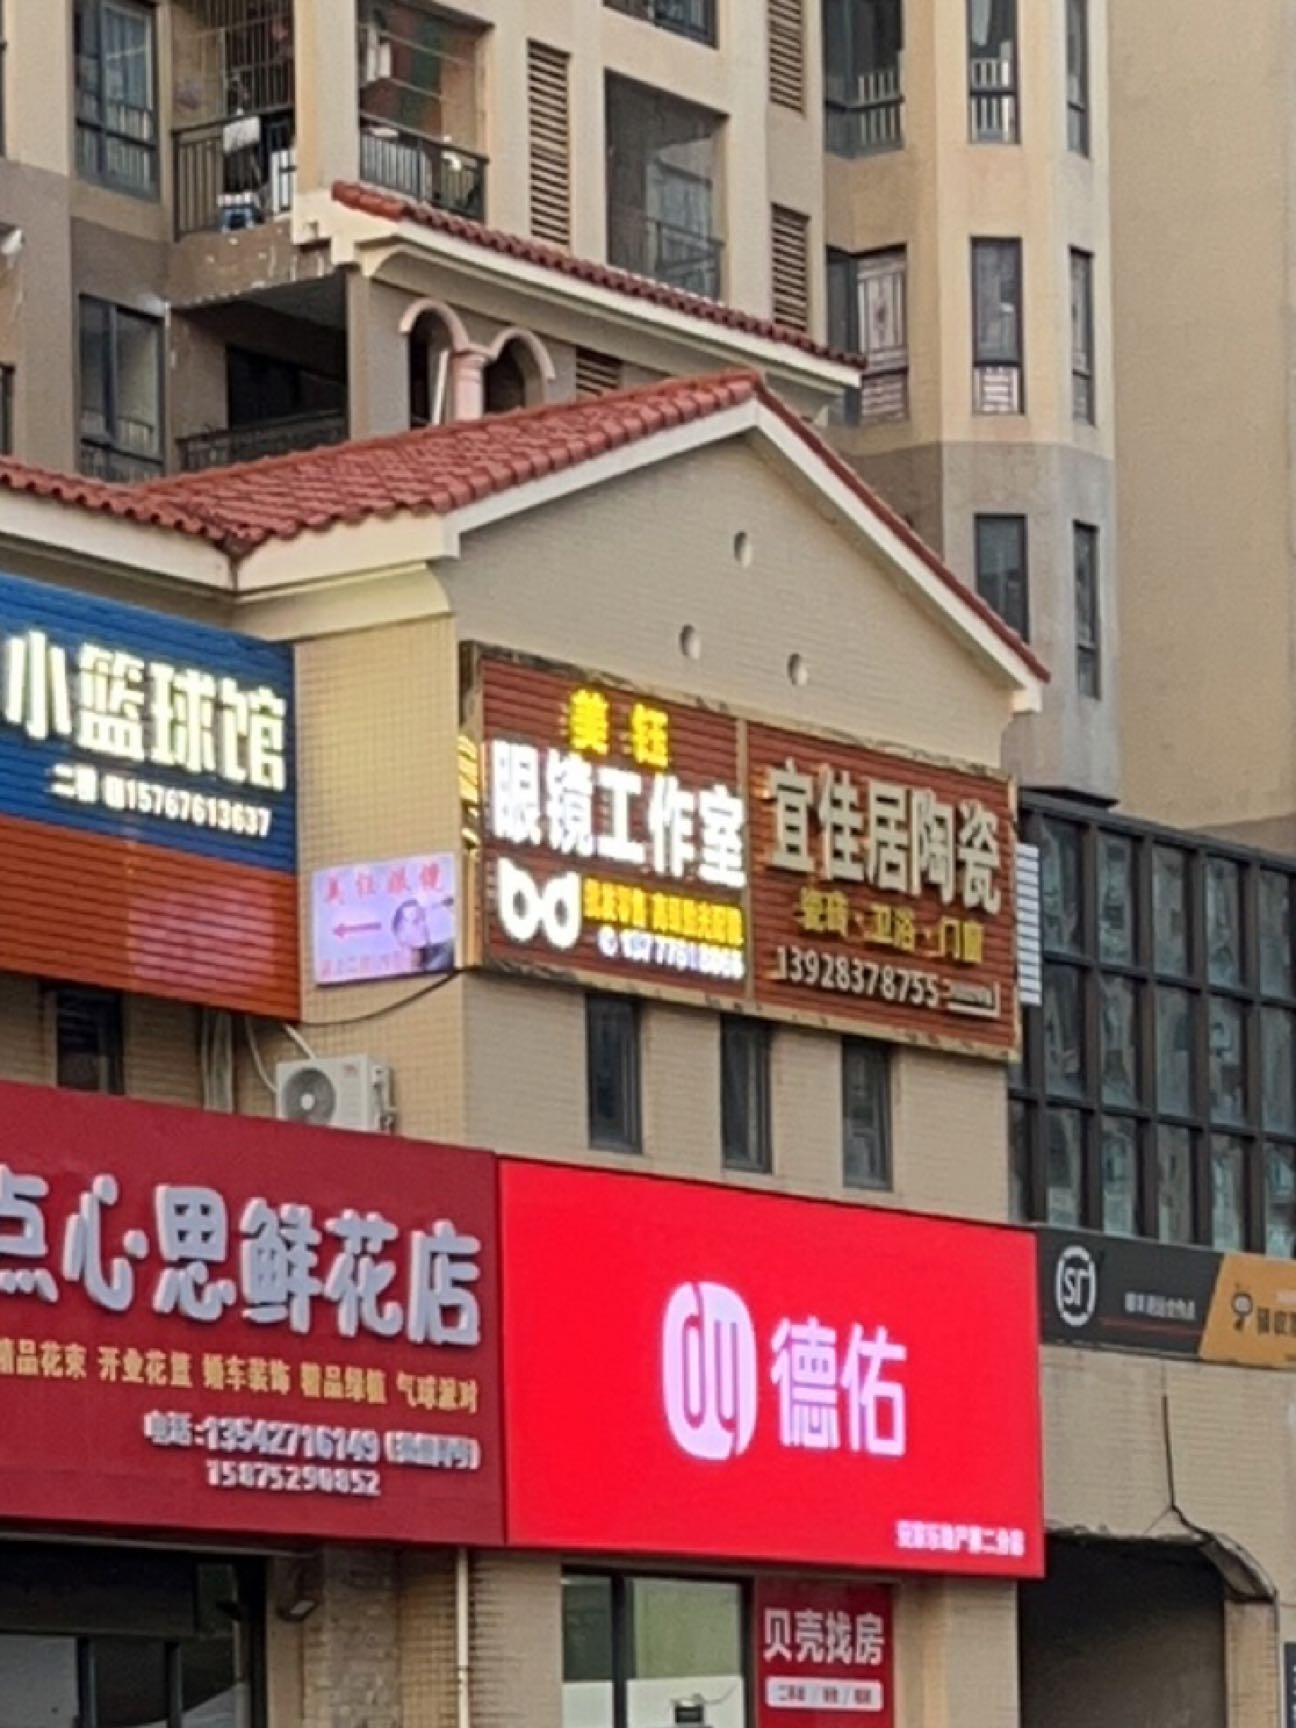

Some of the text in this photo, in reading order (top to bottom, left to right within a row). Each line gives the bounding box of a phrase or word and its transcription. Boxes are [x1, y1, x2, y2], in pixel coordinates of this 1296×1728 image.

[491, 739, 746, 888] 眼镜工作室
[766, 756, 1001, 914] 宜佳居陶瓷
[776, 945, 938, 1008] 13928378755
[770, 1314, 907, 1458] 德佑
[763, 1607, 885, 1666] 贝壳找房
